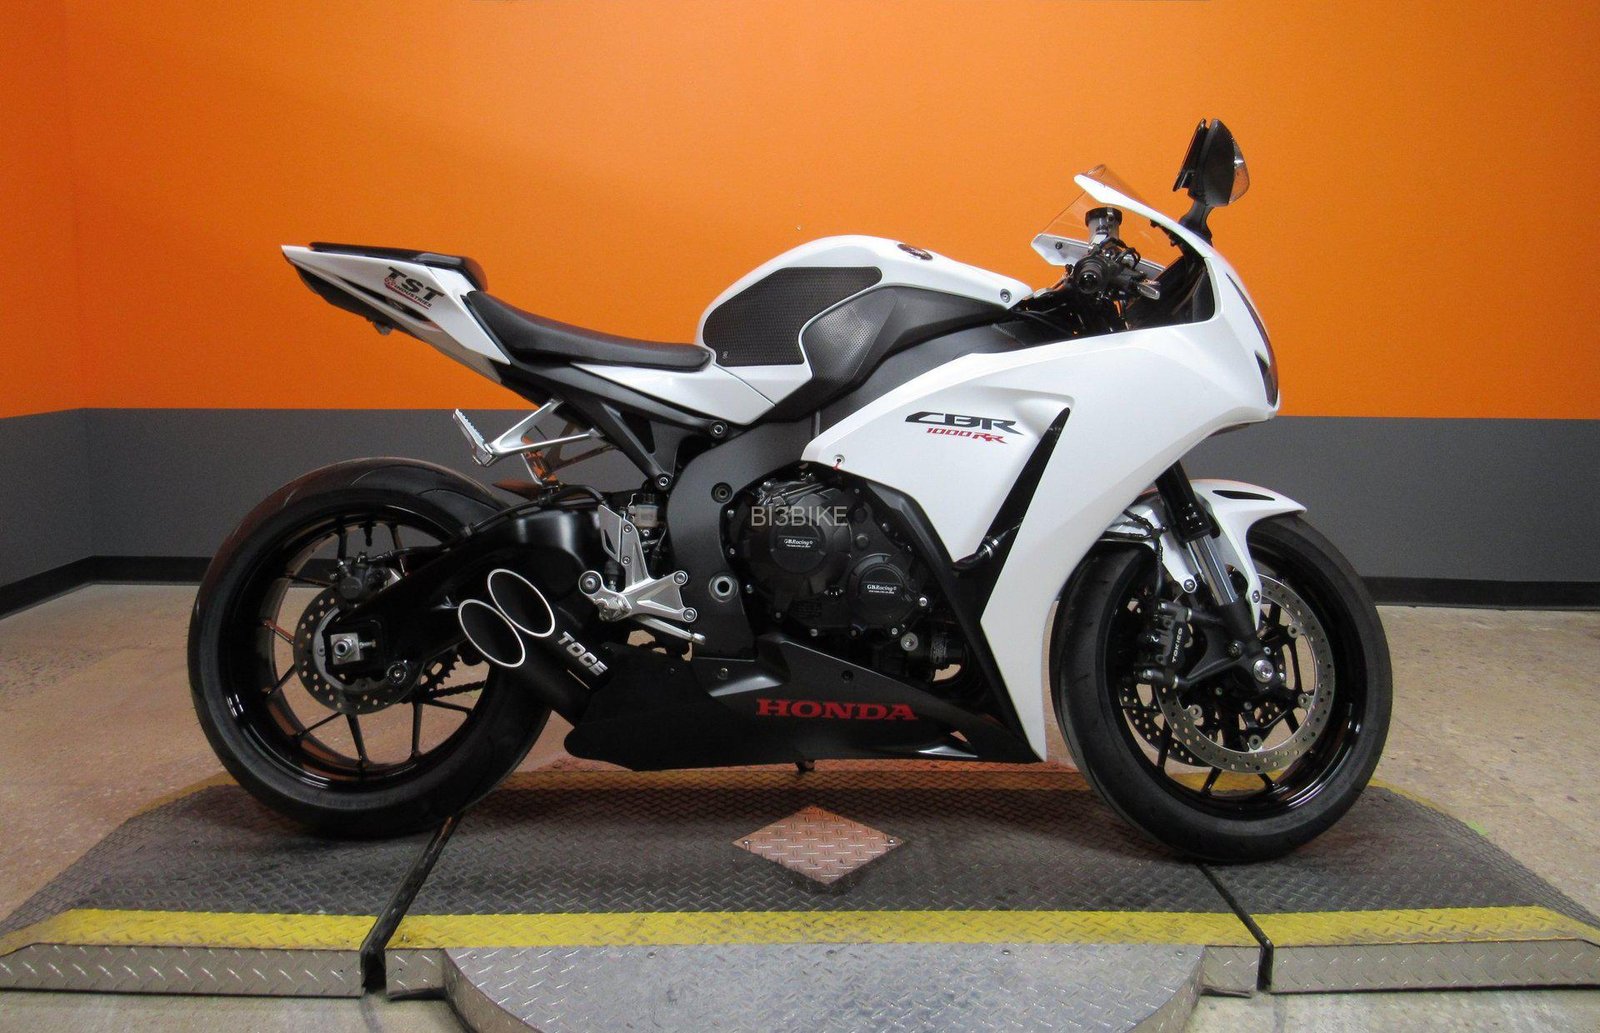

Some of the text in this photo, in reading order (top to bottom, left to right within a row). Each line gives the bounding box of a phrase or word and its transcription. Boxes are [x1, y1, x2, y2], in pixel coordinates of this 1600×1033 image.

[388, 266, 445, 301] TST
[905, 411, 1024, 435] CBR
[558, 631, 609, 676] TOCE
[1172, 627, 1183, 663] TOKICO
[756, 699, 918, 720] HONDA
